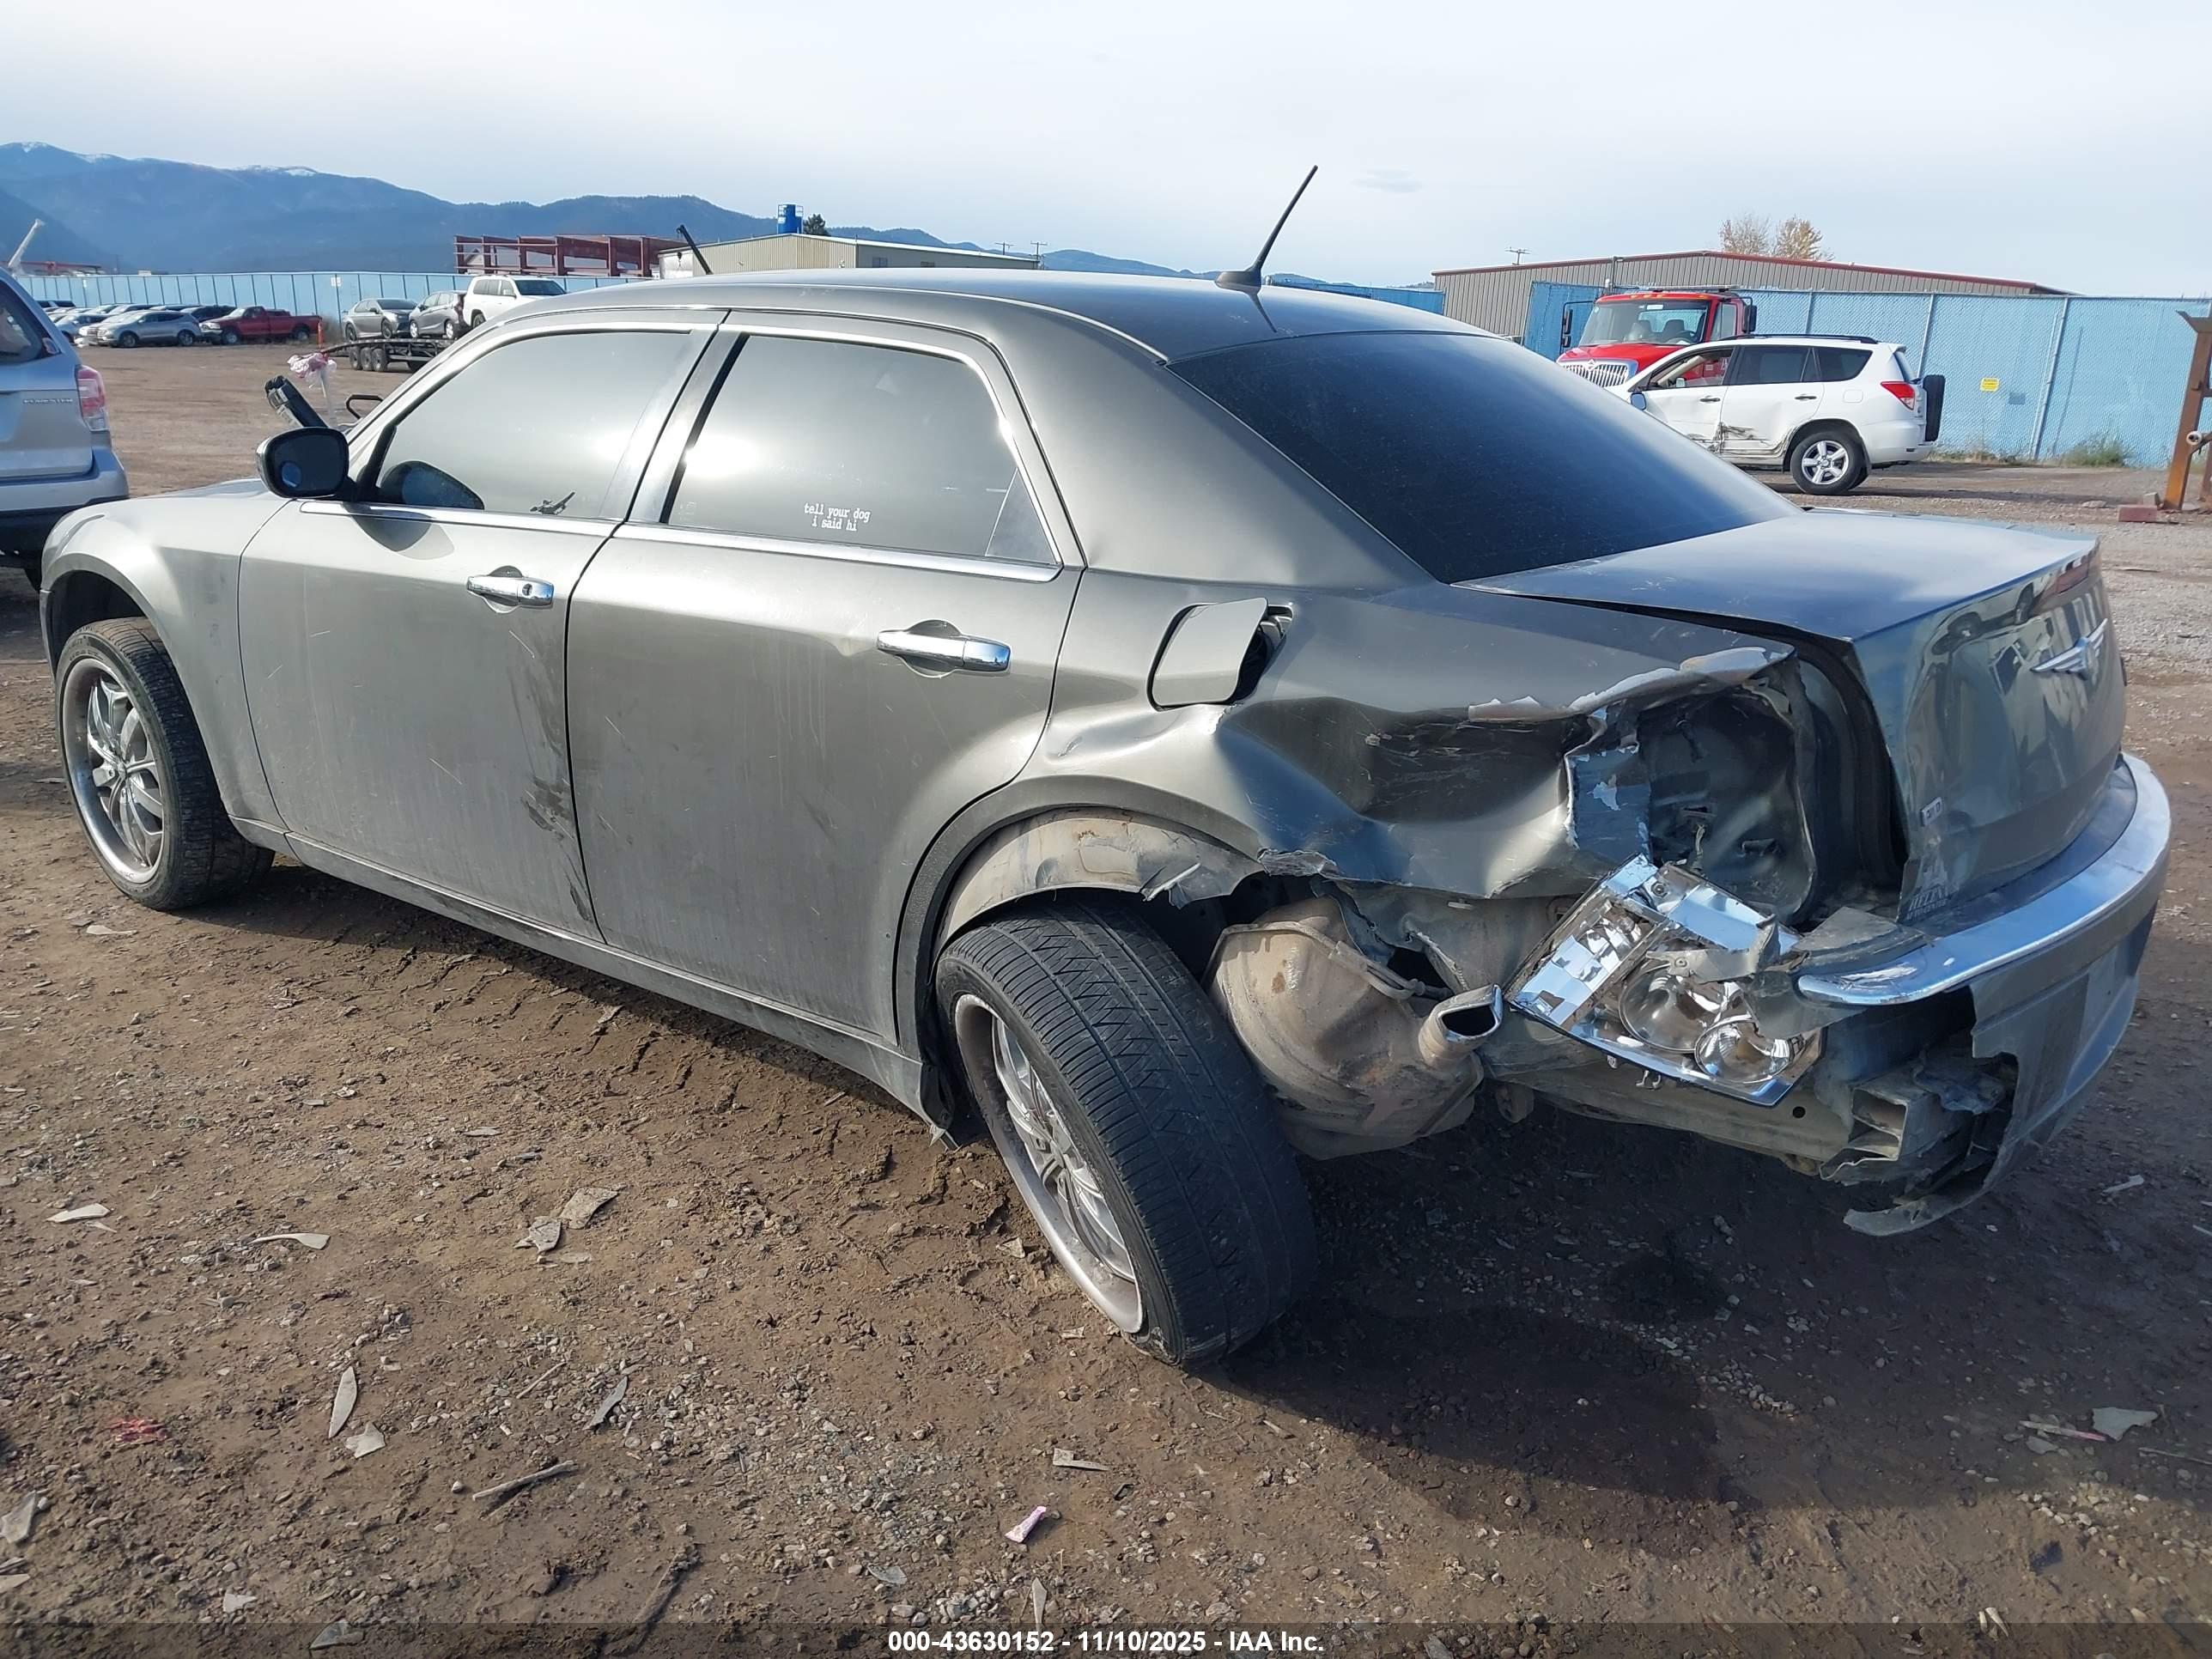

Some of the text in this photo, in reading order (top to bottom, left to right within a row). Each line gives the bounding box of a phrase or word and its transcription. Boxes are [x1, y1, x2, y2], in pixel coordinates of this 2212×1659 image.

[804, 502, 871, 523] tell your dog
[821, 518, 842, 530] said
[846, 520, 857, 532] hi
